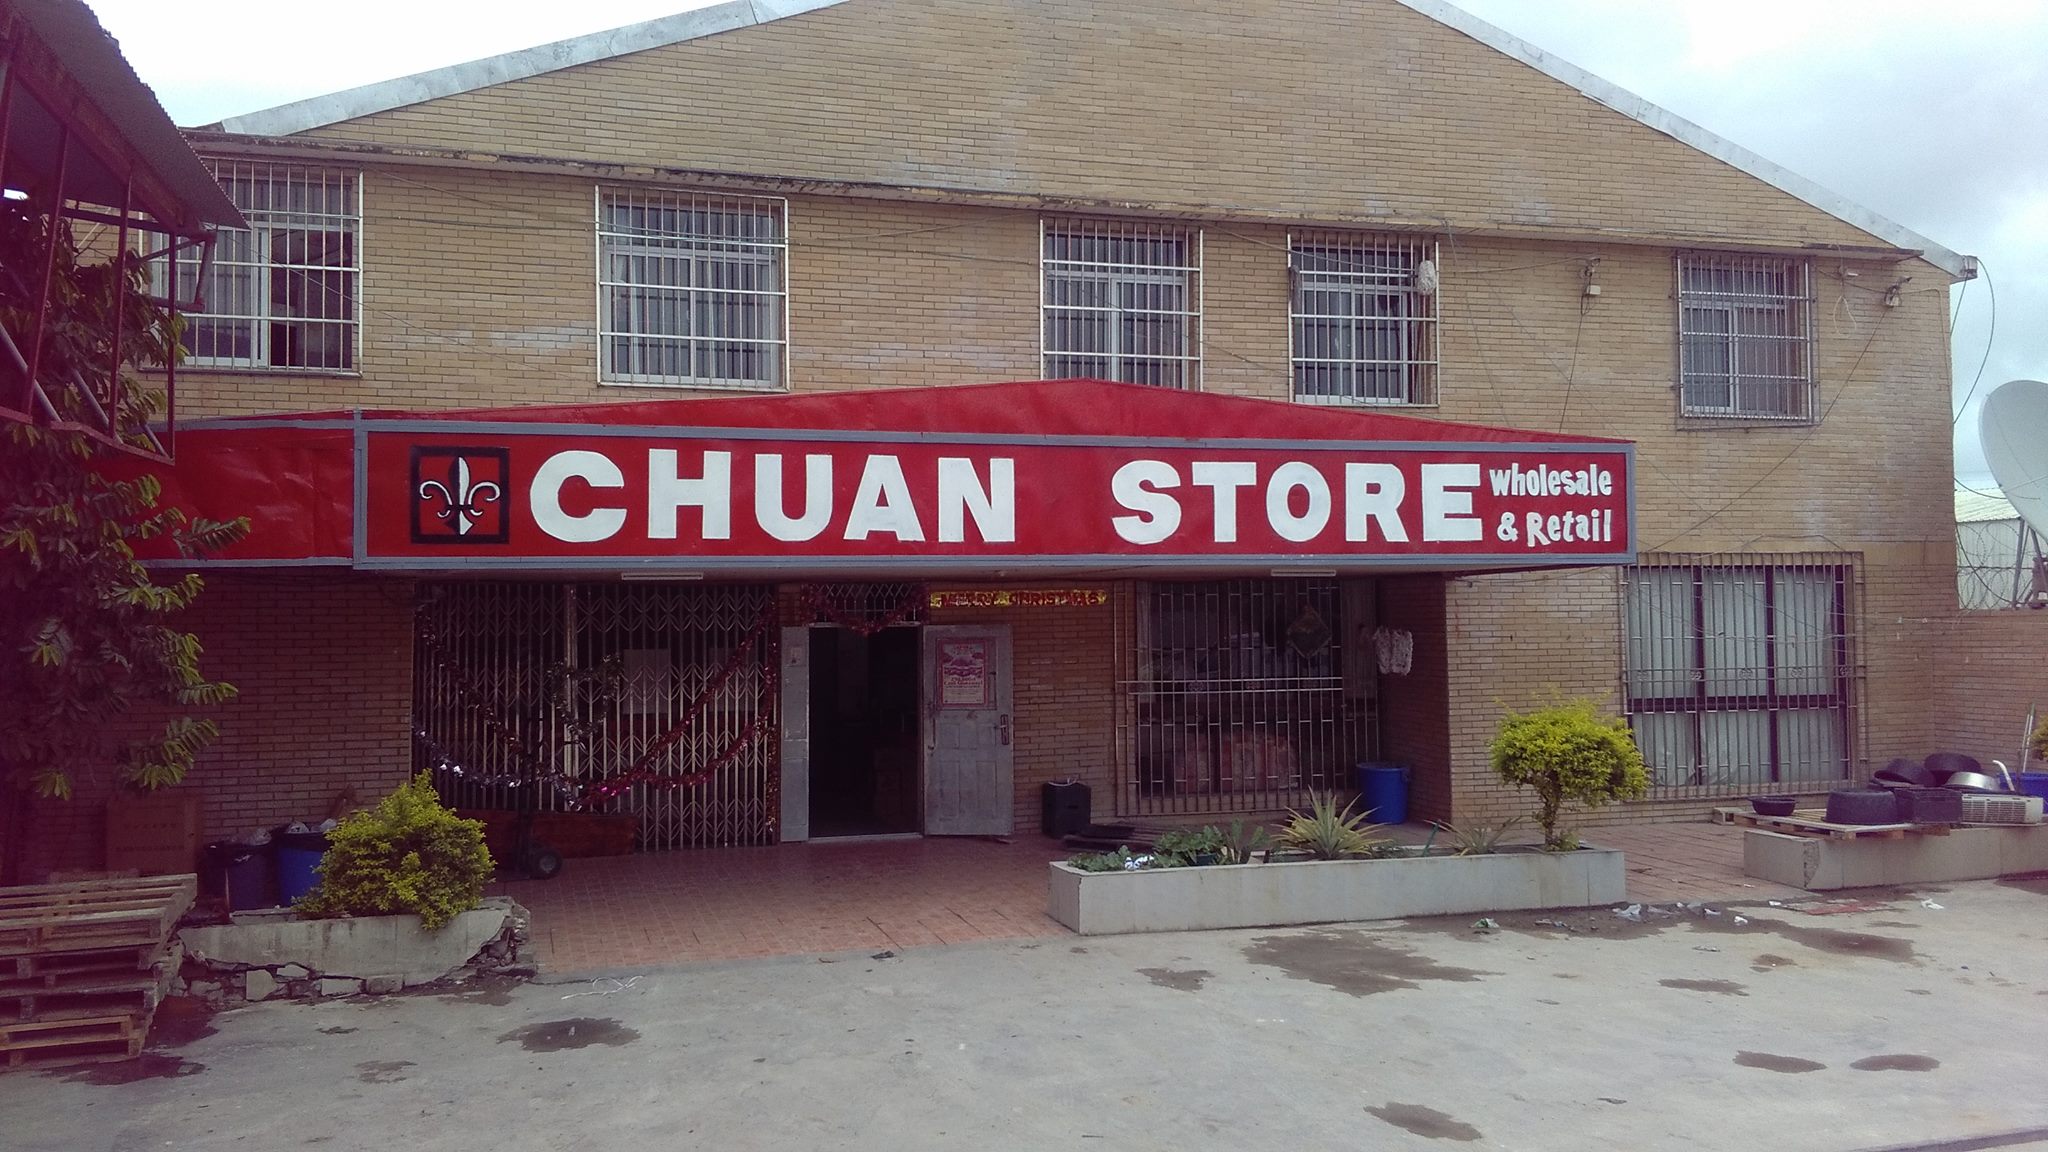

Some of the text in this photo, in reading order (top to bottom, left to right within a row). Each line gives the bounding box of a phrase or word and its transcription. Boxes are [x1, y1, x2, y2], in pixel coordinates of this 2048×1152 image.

[529, 448, 1484, 545] CHUAN STORE
[1496, 508, 1613, 548] & Retail
